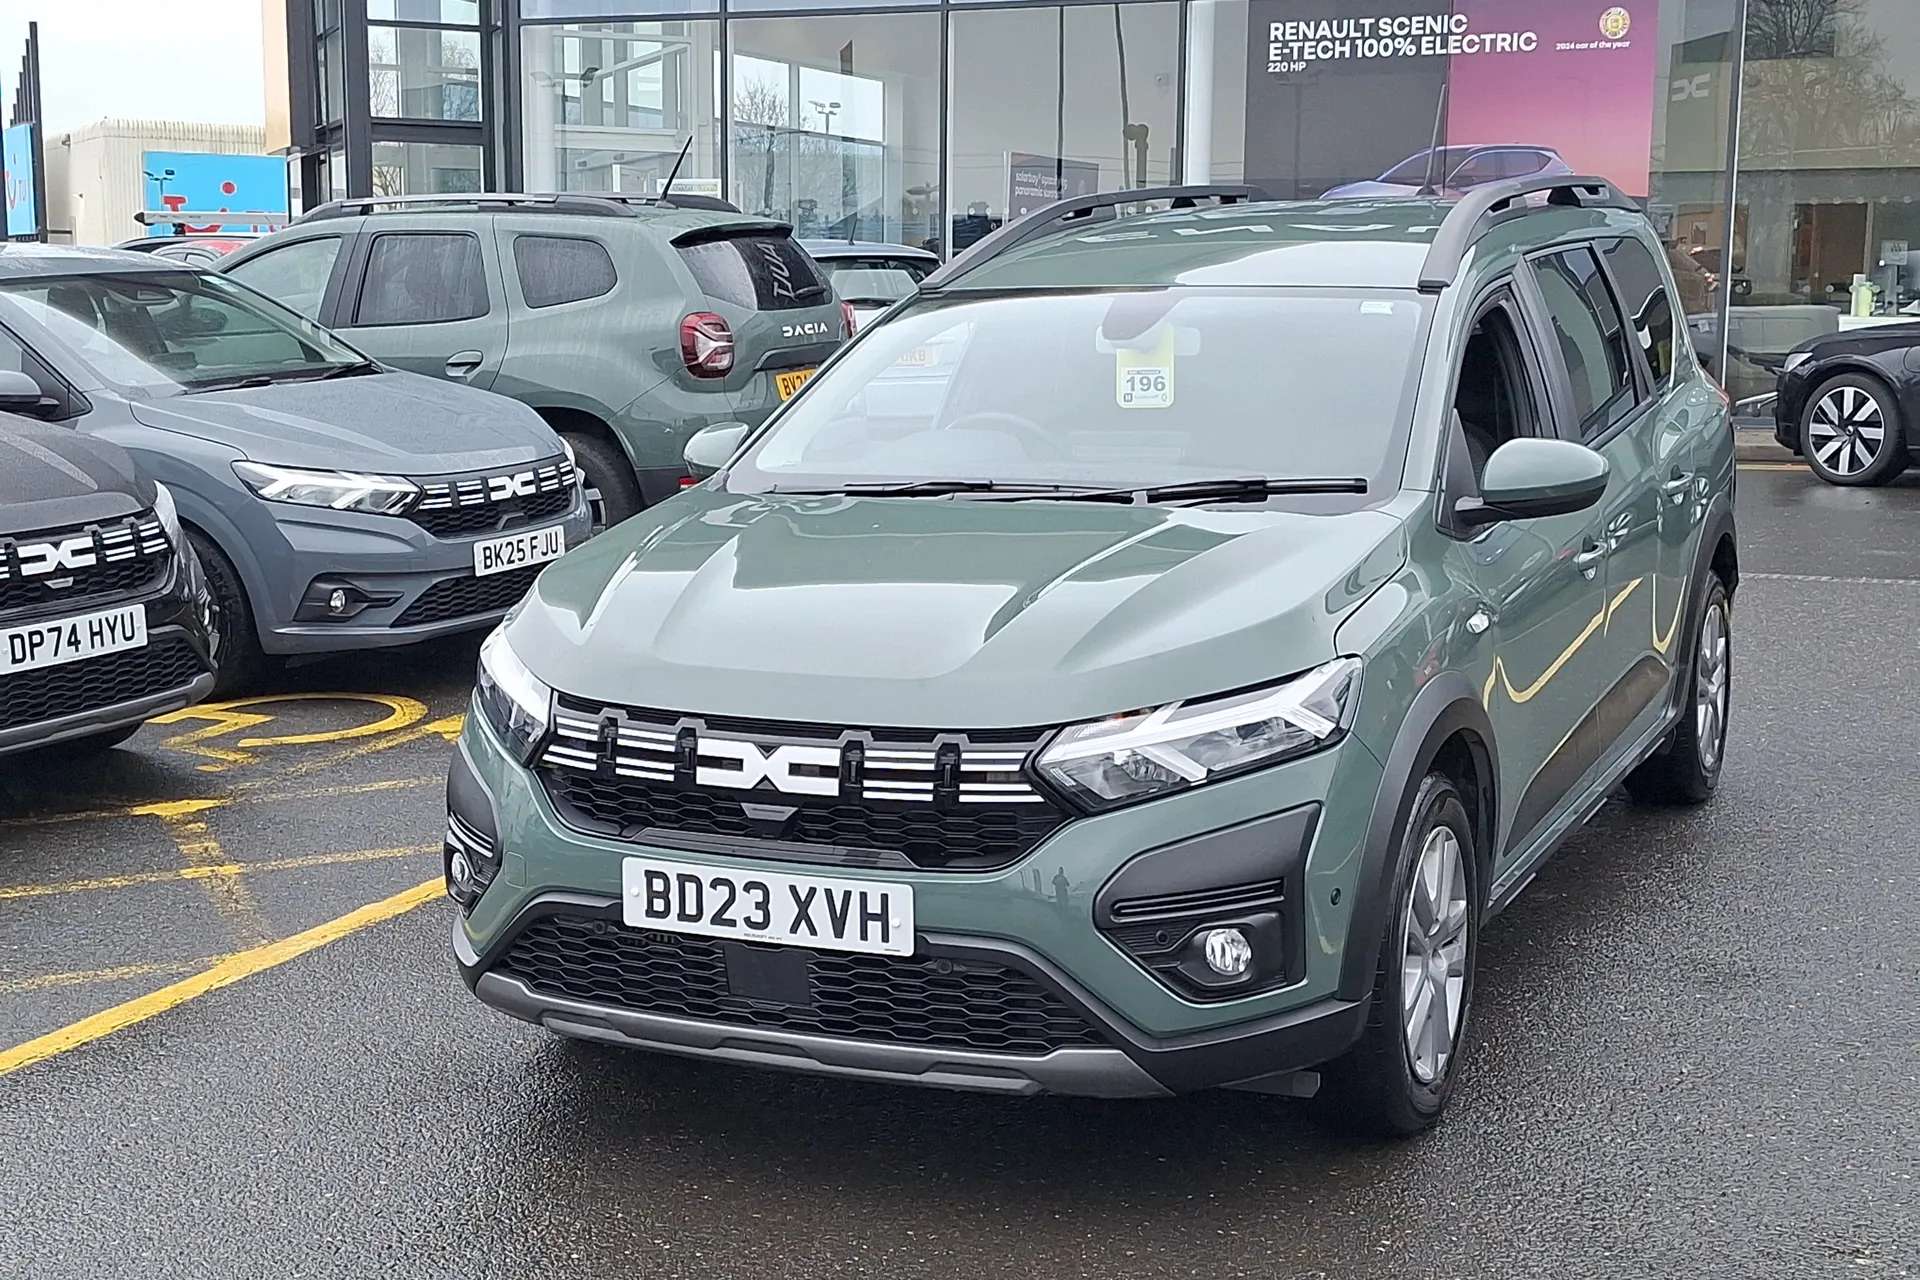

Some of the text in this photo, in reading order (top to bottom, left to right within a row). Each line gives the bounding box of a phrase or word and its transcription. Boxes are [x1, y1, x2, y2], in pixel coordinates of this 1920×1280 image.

[1270, 14, 1468, 41] RENAULT SCENIC
[1269, 31, 1538, 61] E-TECH 100% ELECTRIC
[1267, 61, 1307, 72] 220 HP
[782, 322, 828, 338] DACIA
[1126, 375, 1166, 392] 196
[482, 530, 559, 570] BK25 FJU
[8, 611, 136, 665] DP74 HYU
[644, 869, 891, 944] BD23 XVH
